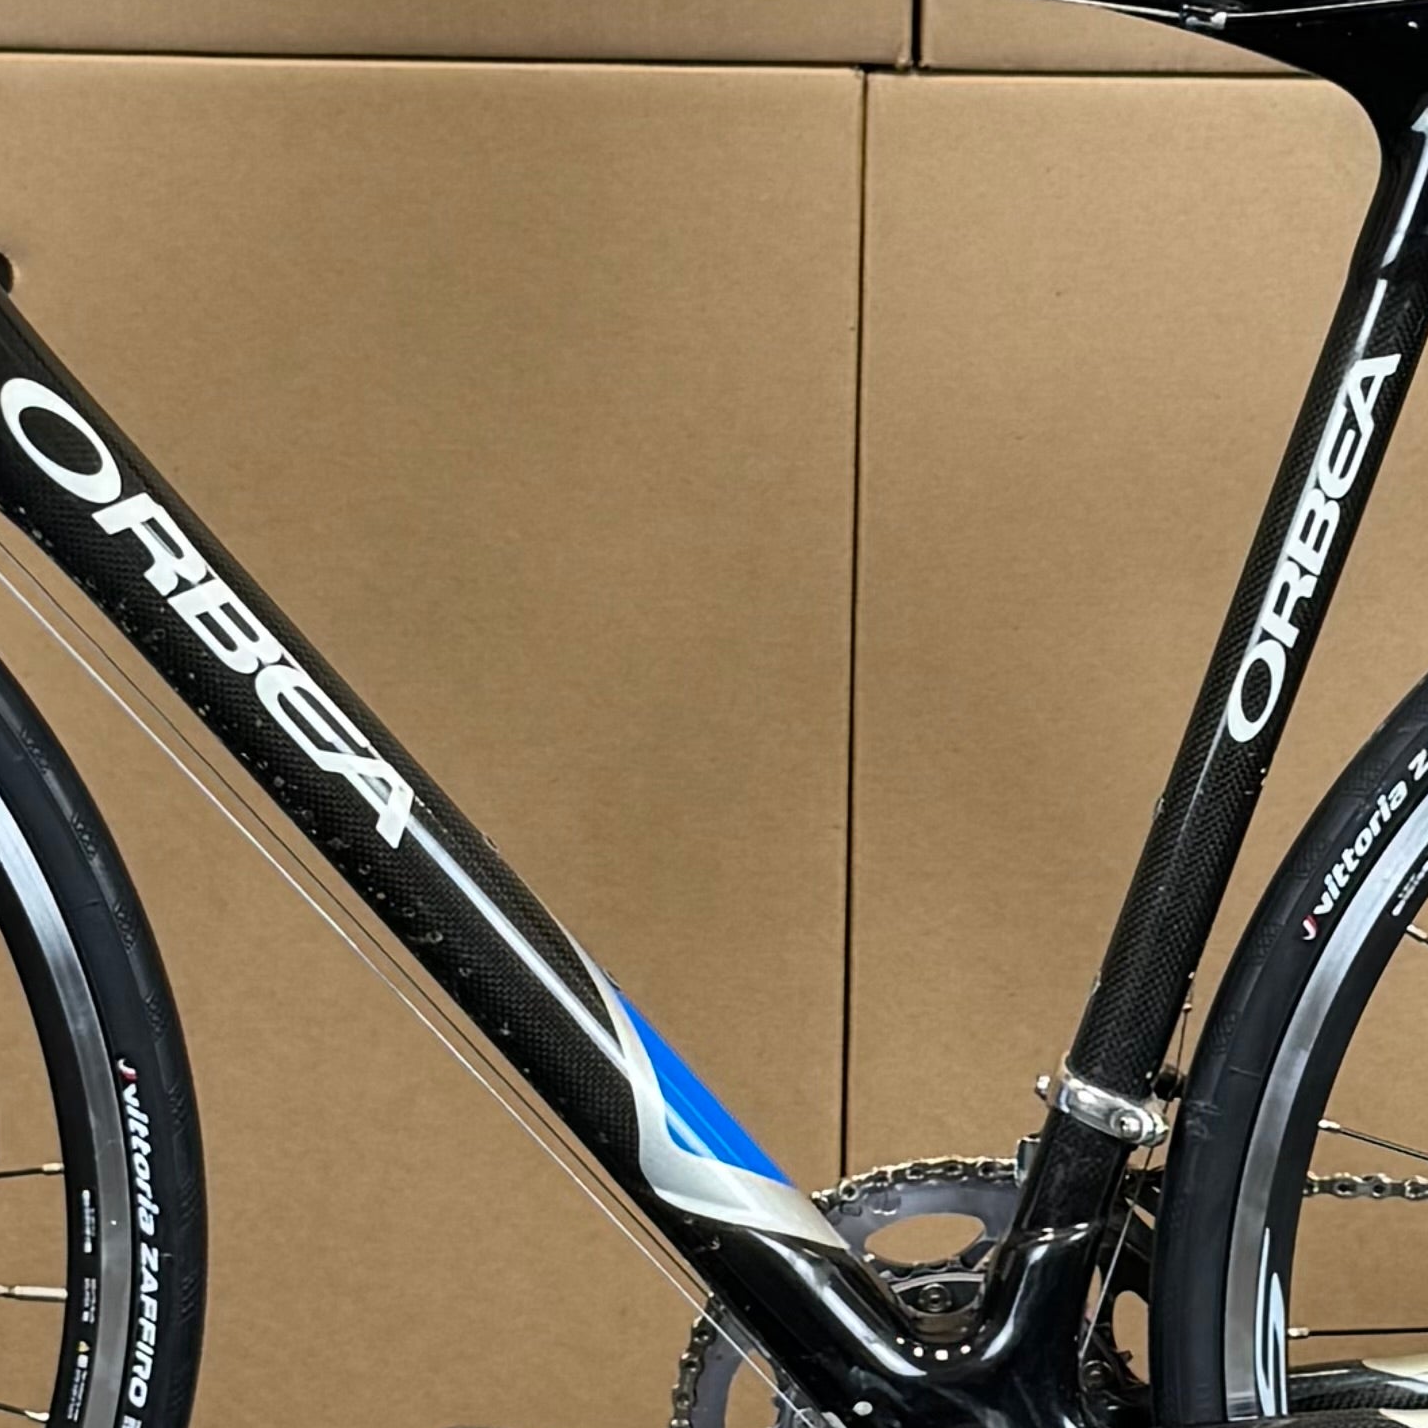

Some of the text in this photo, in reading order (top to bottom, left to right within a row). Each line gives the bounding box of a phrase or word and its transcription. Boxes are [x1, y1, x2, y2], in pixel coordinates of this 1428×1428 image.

[0, 377, 415, 849] ORBEA
[1227, 353, 1401, 743] ORBEA
[128, 1242, 160, 1409] ZAFFIRO
